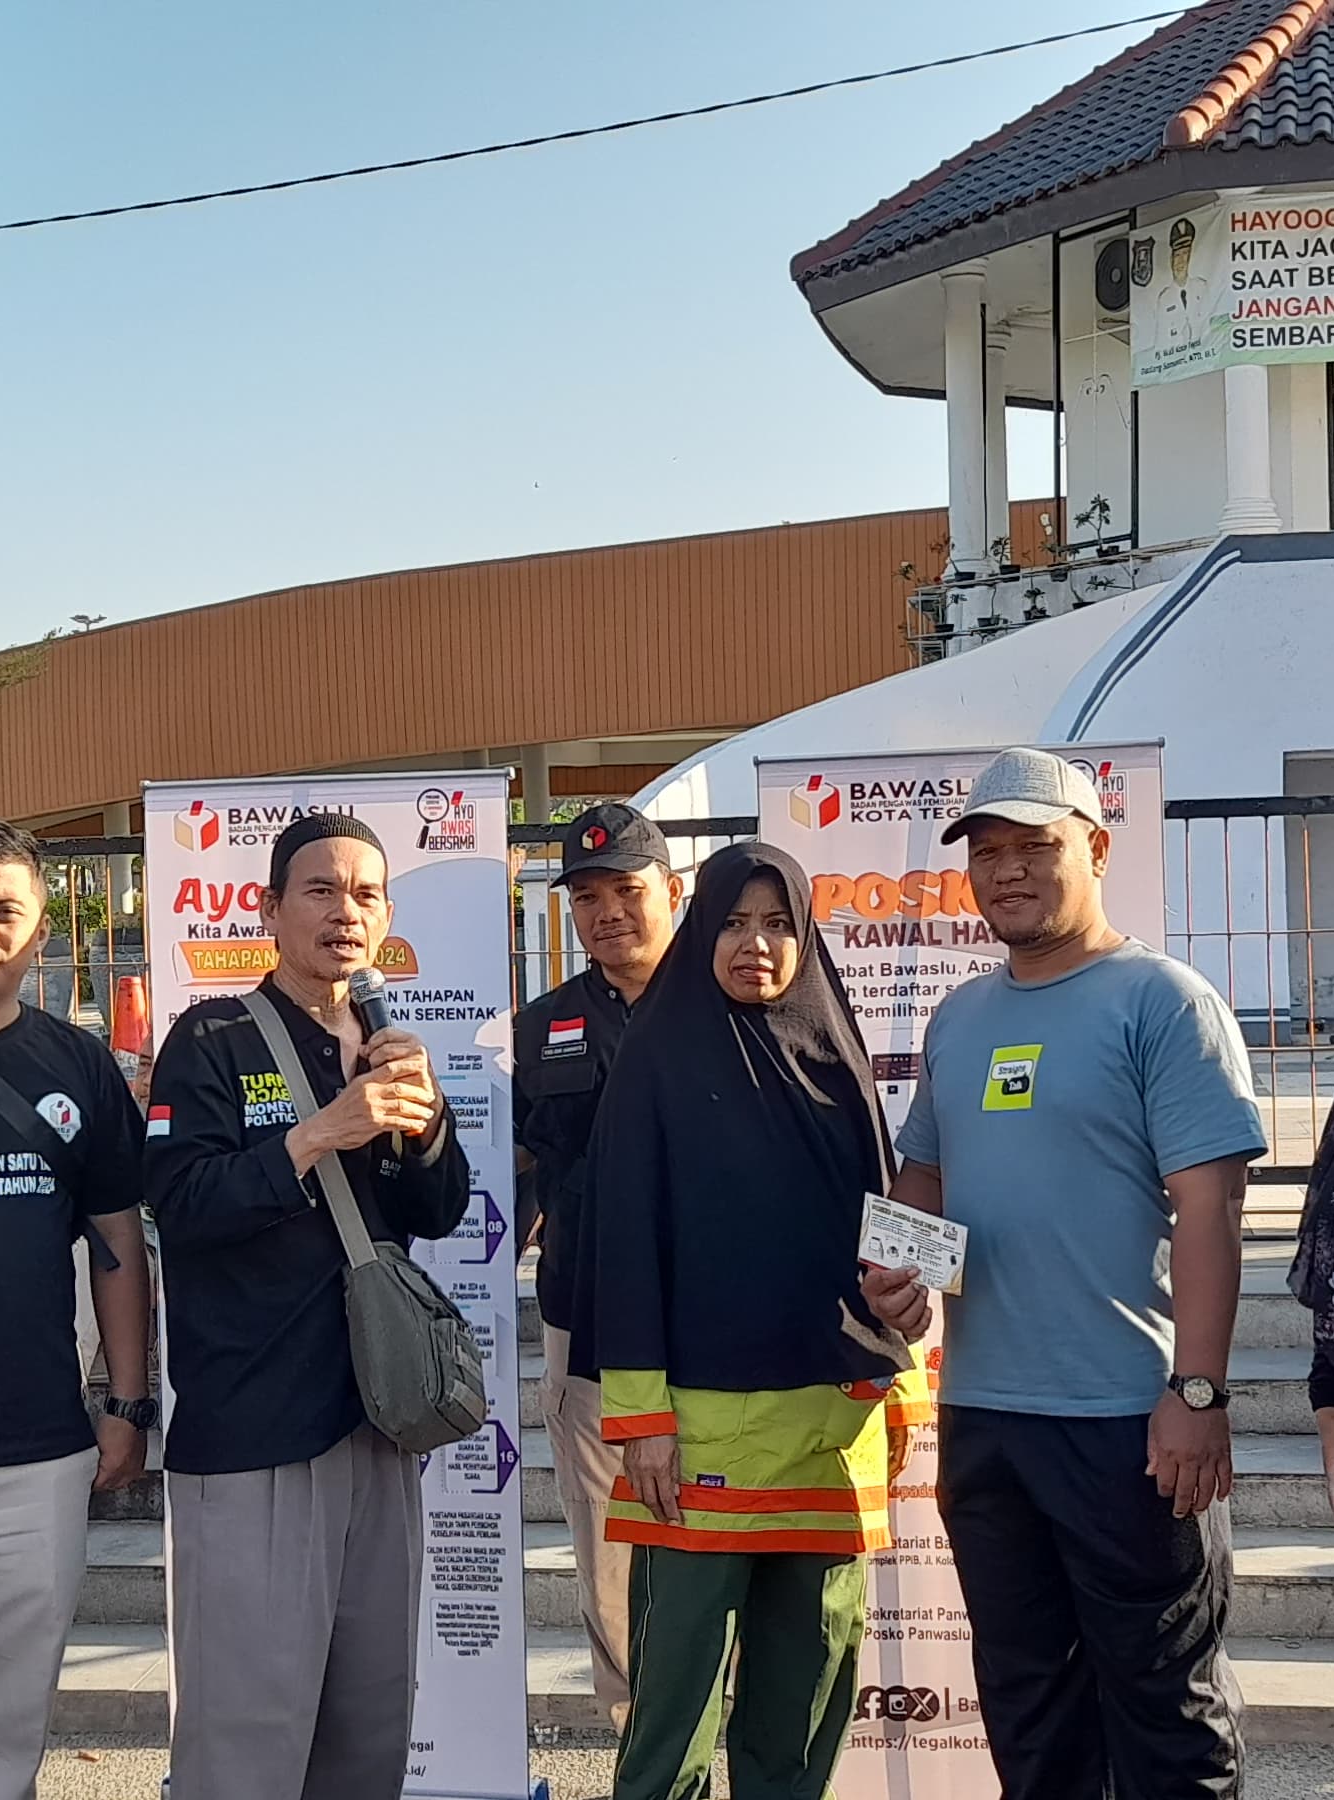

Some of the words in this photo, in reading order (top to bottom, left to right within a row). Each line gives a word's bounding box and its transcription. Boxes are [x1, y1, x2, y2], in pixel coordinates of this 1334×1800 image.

[1231, 239, 1289, 261] KITA
[1231, 267, 1299, 291] SAAT
[1102, 775, 1124, 791] AYO
[454, 804, 474, 819] AYO
[851, 801, 877, 809] BADAN
[879, 799, 922, 808] PENGAWAS
[851, 809, 913, 823] KOTA
[919, 807, 962, 820] TEG
[441, 820, 474, 835] AWASI
[428, 835, 475, 850] BERSAMA
[173, 878, 264, 922] Ayo
[811, 869, 980, 923] POSK
[188, 923, 222, 939] Kita
[844, 920, 942, 948] KAWAL
[192, 948, 277, 969] TAHAPAN
[880, 960, 962, 977] Bawaslu,
[403, 990, 475, 1003] TAHAPAN
[863, 983, 939, 998] terdaftar
[415, 1007, 497, 1021] SERENTAK
[244, 1101, 292, 1115] MONEY
[7, 1153, 37, 1171] SATU
[487, 1220, 503, 1233] 08
[500, 1451, 515, 1463] 16
[868, 1556, 897, 1568] omplek
[864, 1607, 933, 1621] Sekretariat
[865, 1627, 904, 1640] Posko
[908, 1627, 971, 1641] Panwaslu
